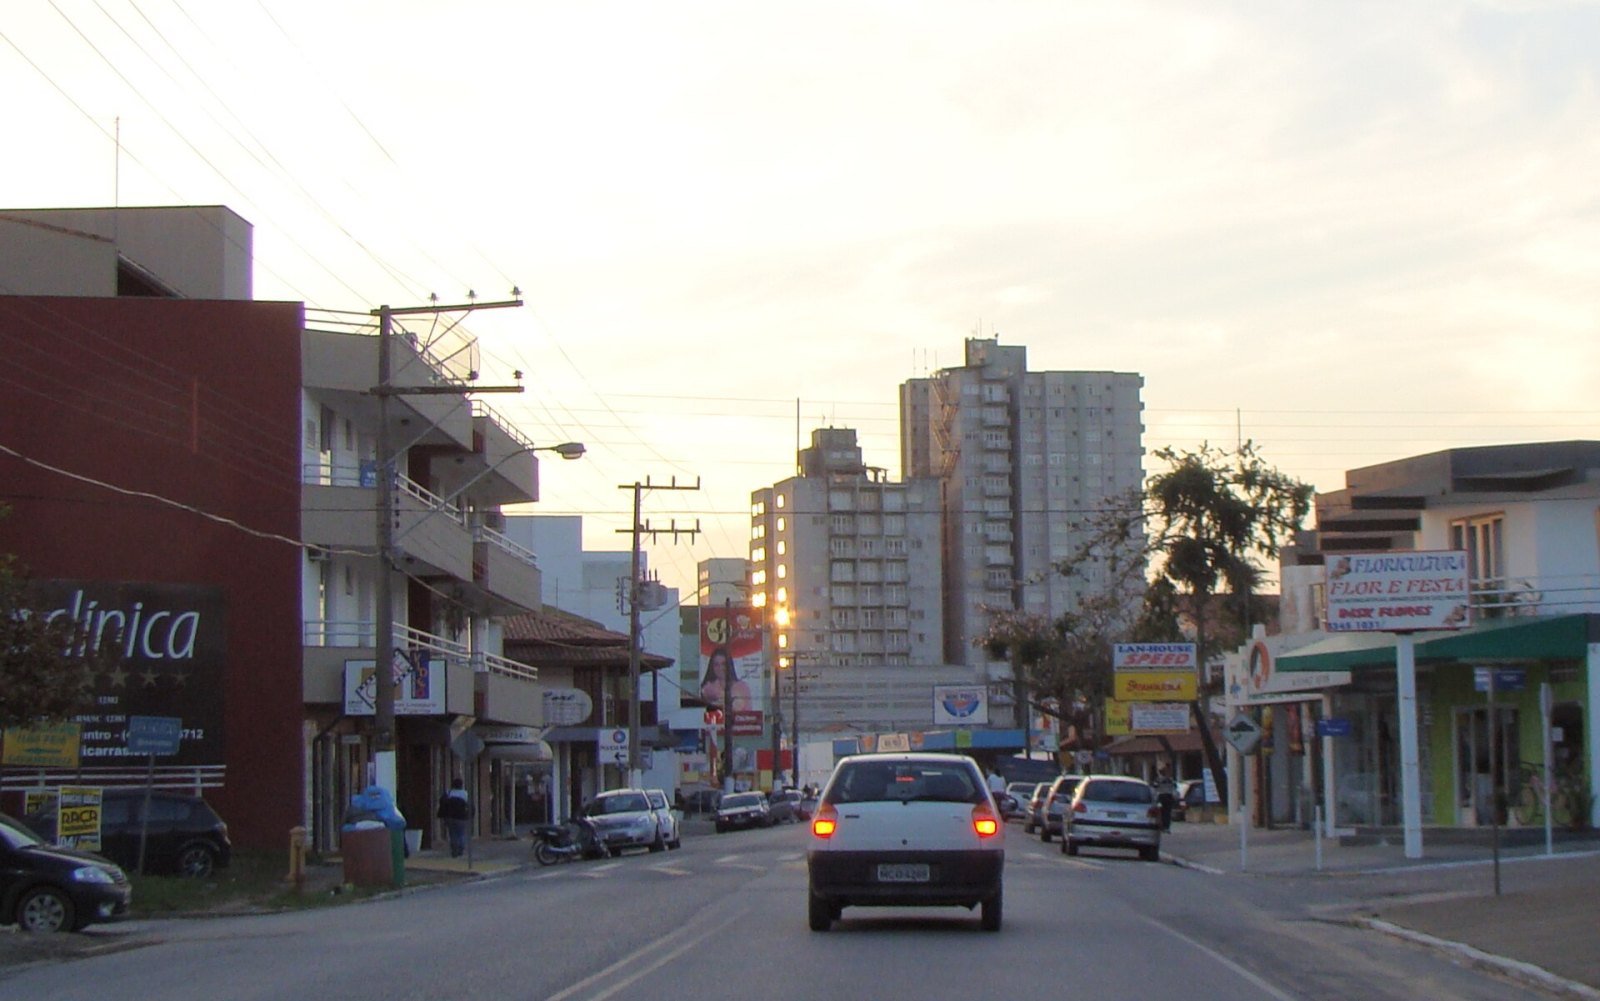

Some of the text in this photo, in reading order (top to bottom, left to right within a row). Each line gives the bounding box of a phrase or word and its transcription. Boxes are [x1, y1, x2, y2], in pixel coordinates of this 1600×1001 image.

[1354, 555, 1466, 573] FLORICULTURA
[1330, 577, 1465, 595] FLOR E FESTA
[1377, 605, 1433, 618] FLORES
[1118, 645, 1192, 654] LAN-HOUSE
[1123, 653, 1190, 665] SPEED
